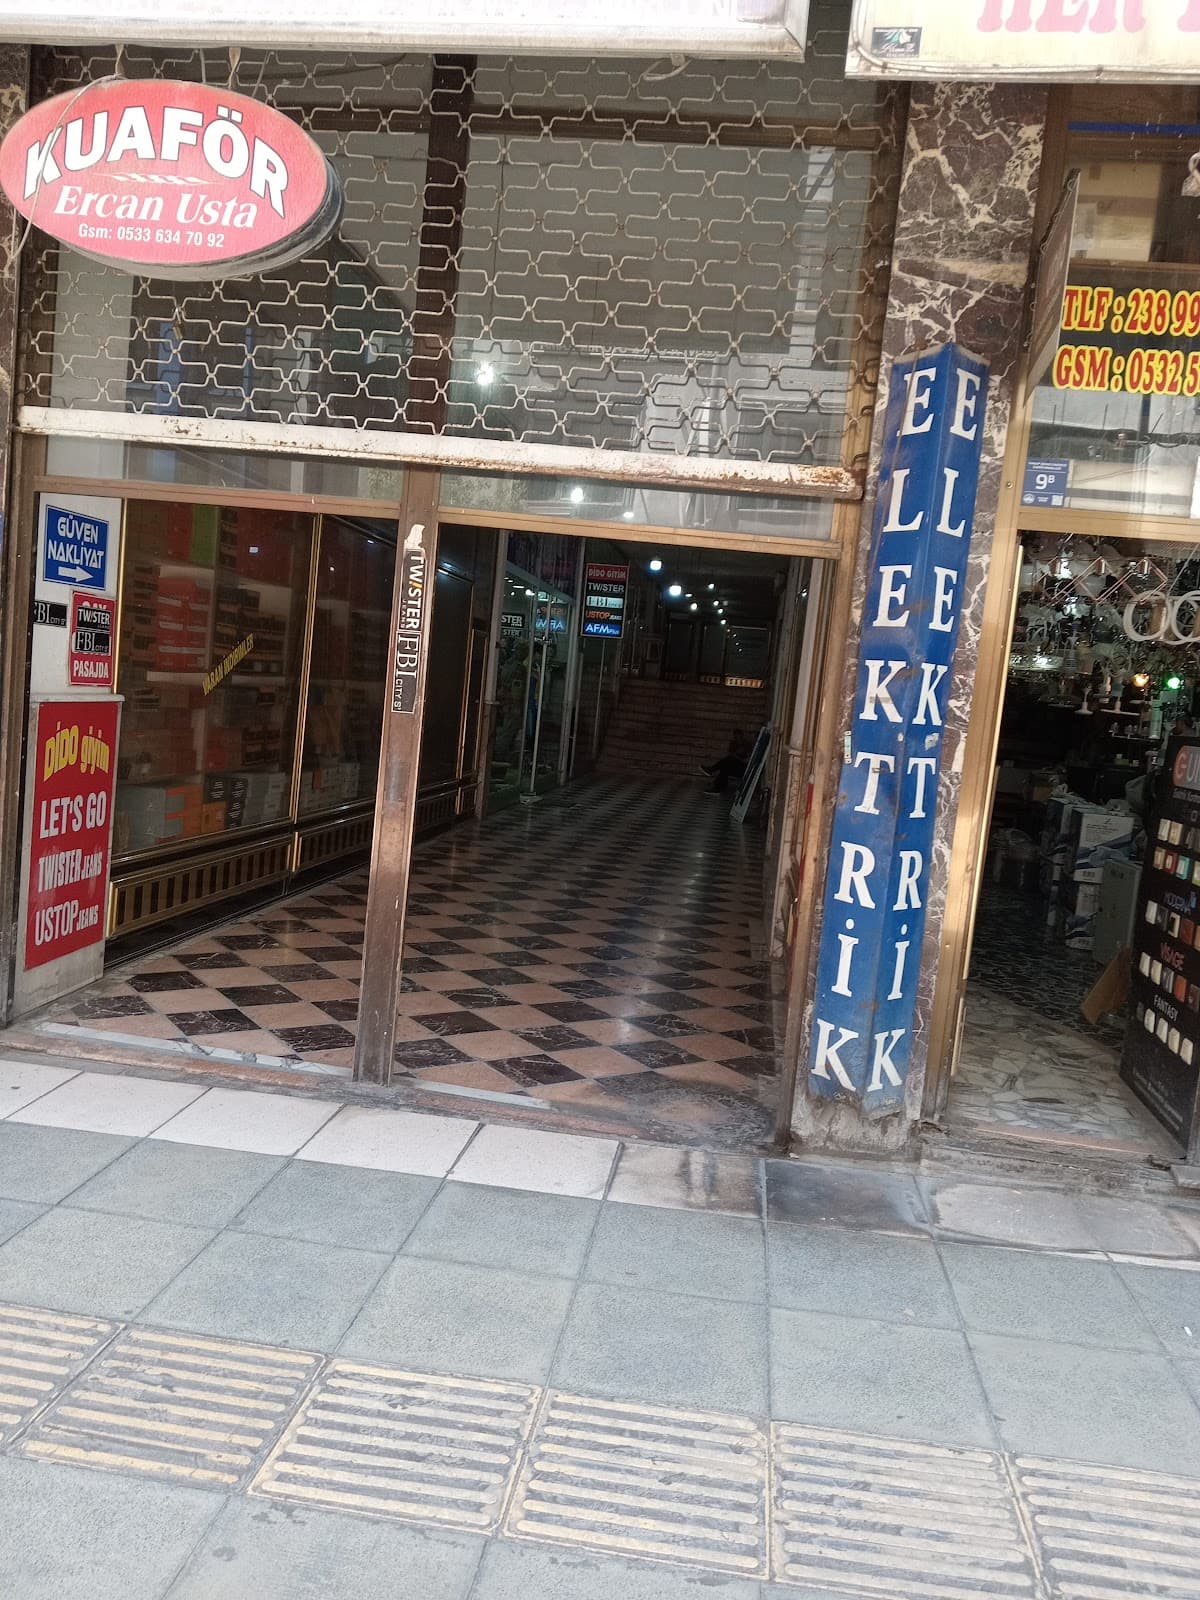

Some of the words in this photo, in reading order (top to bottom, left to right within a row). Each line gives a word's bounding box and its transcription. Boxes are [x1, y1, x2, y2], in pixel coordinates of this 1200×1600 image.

[23, 104, 289, 219] KUAFÖR
[54, 185, 164, 221] Ercan
[175, 193, 258, 229] Usta
[78, 223, 112, 240] Gsm:
[117, 224, 151, 242] 0533
[155, 227, 181, 244] 634
[186, 230, 202, 247] 70
[207, 232, 225, 248] 92
[1124, 288, 1171, 335] 238
[1125, 348, 1184, 395] 0532
[57, 515, 99, 545] GÜVEN
[47, 538, 105, 569] NAKLİYAT
[76, 632, 96, 652] FBI
[395, 634, 420, 679] FBI
[73, 660, 109, 679] PASAJDA
[44, 721, 79, 783] DİDO
[80, 726, 110, 775] giyim
[811, 367, 937, 1092] ELEKTRİK
[866, 367, 981, 1092] ELEKTRİK
[39, 794, 84, 840] LET'S
[85, 791, 107, 830] GO
[37, 848, 83, 894] TWISTER
[81, 851, 103, 881] JEANS
[34, 899, 79, 946] USTOP
[76, 904, 99, 932] JEANS
[1153, 994, 1180, 1022] FANTASY
